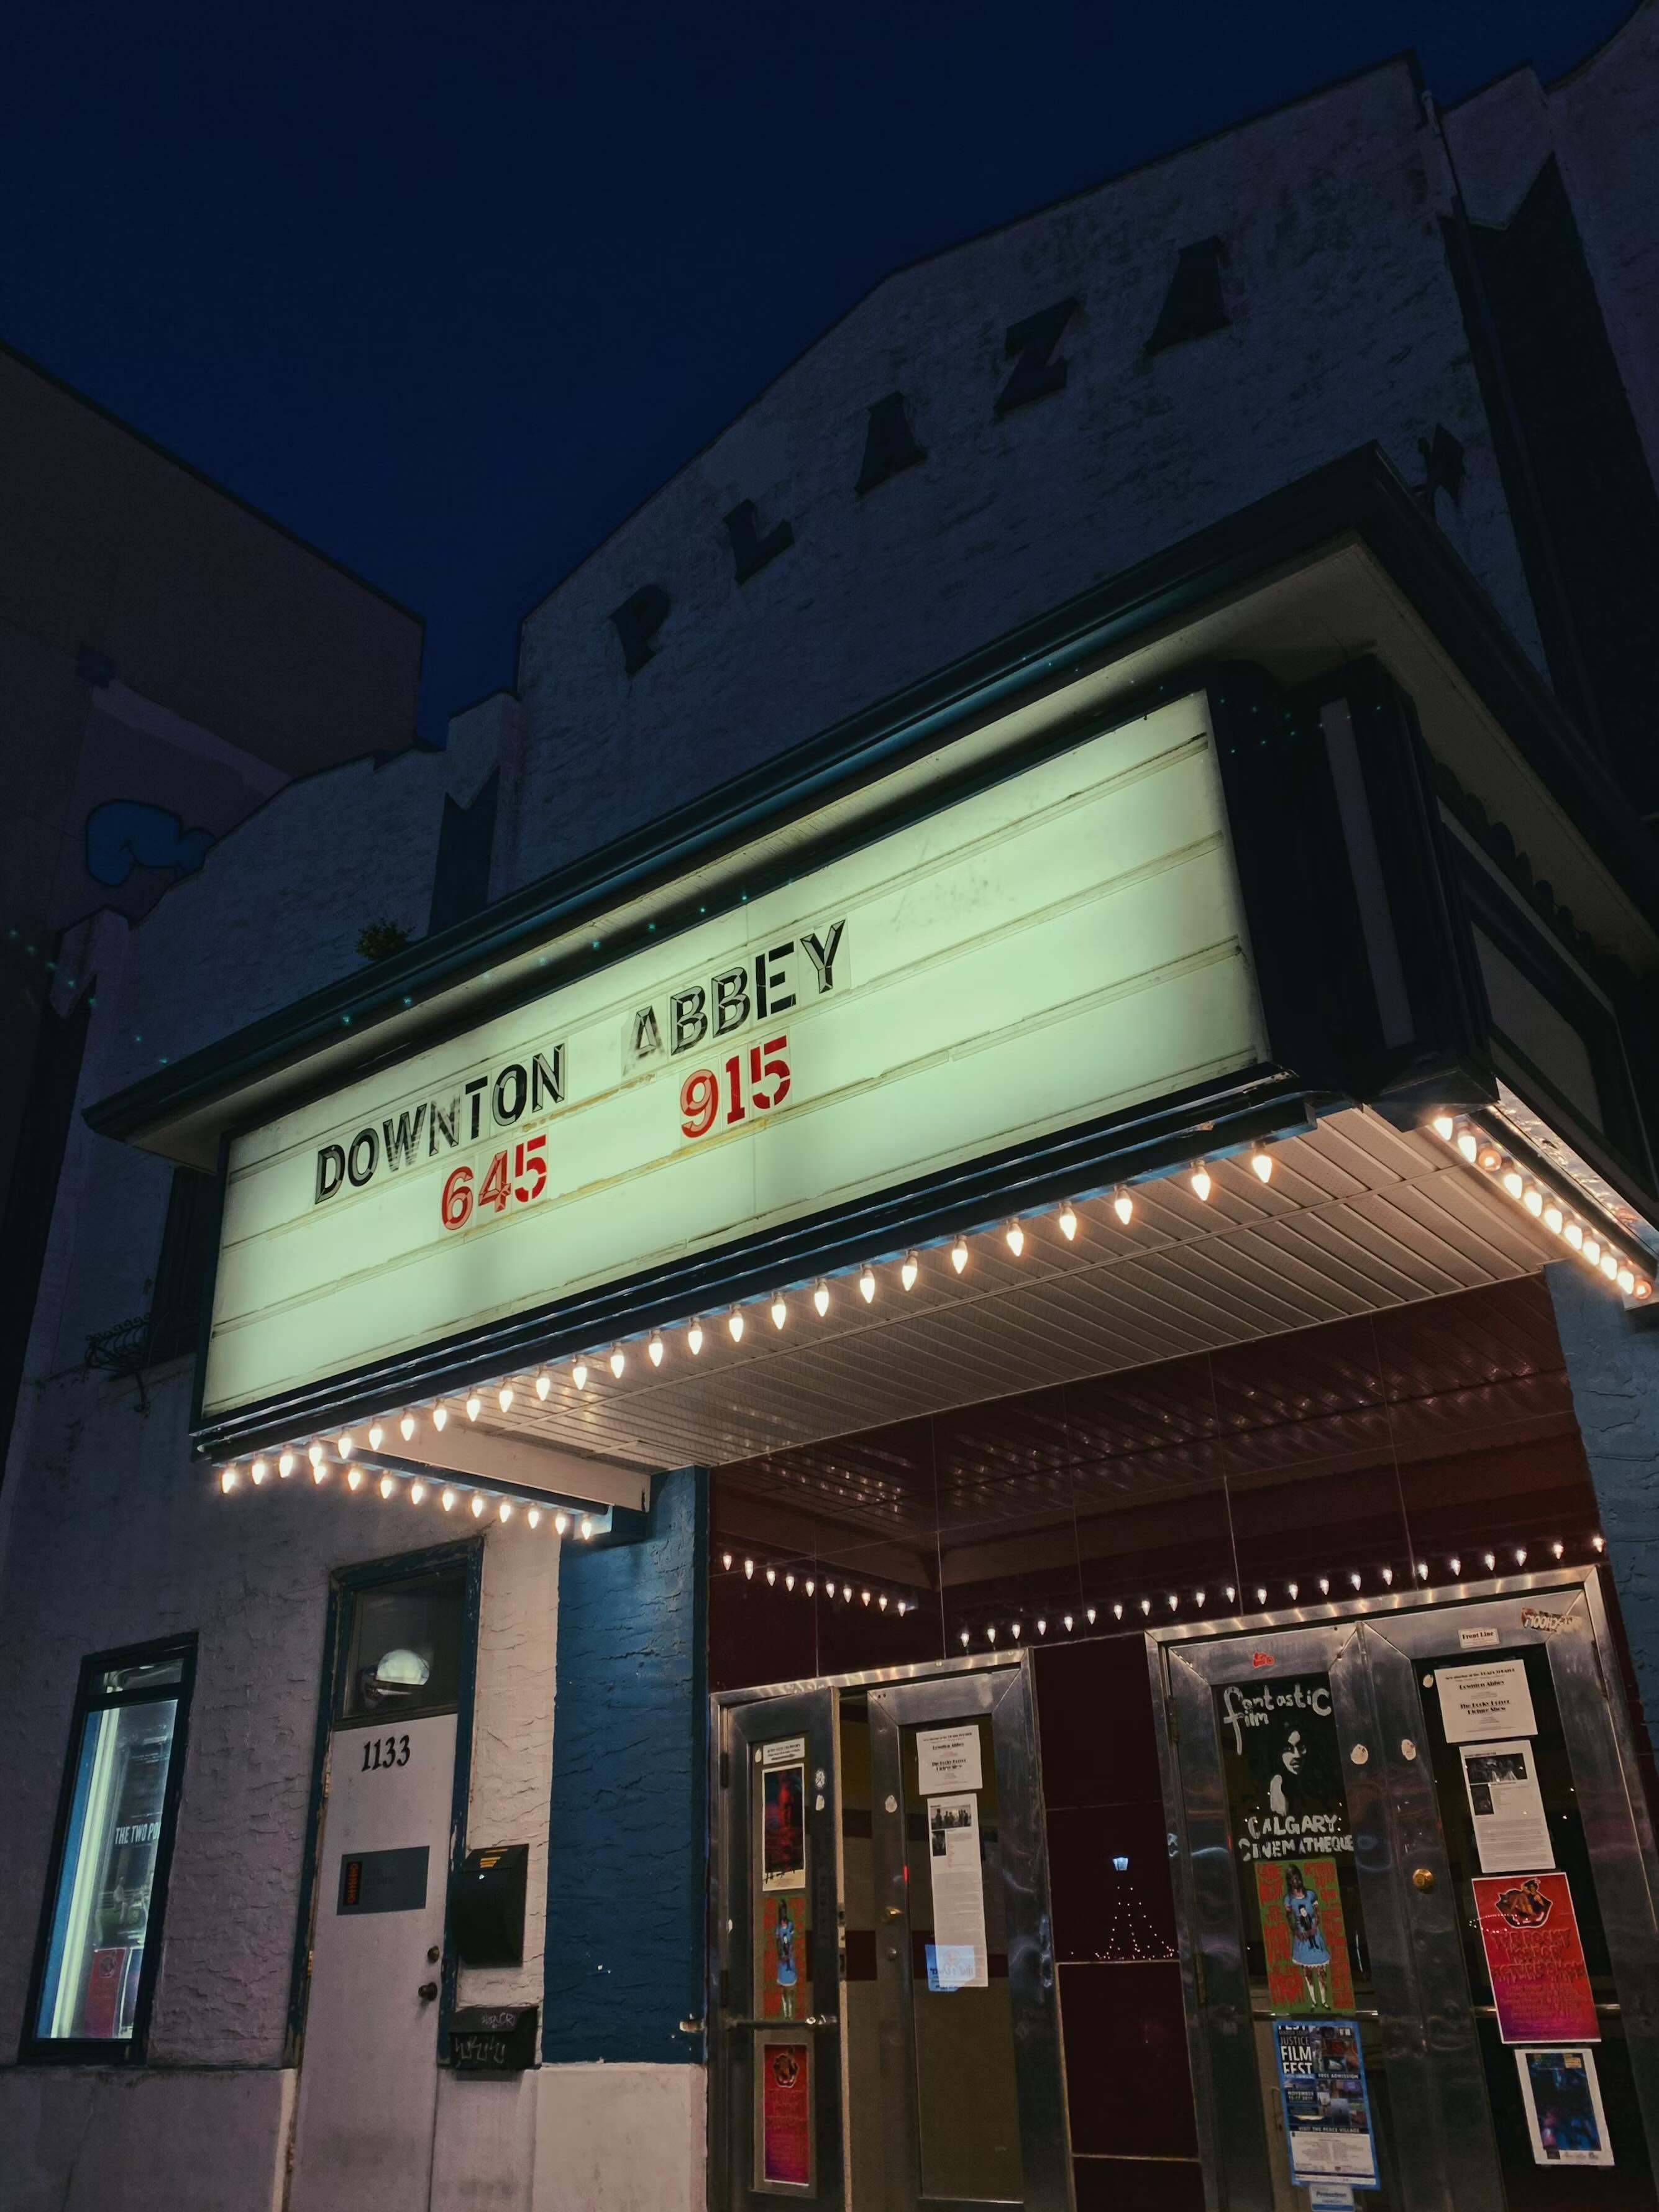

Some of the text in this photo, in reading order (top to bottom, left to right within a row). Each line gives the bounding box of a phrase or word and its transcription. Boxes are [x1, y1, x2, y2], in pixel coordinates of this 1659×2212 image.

[607, 235, 1232, 681] PLAZA
[315, 920, 846, 1205] DOWNTON ABBEY
[442, 1035, 790, 1230] 645 915
[362, 1734, 410, 1772] 1133
[115, 1821, 161, 1845] THE TWO PO
[1248, 1814, 1338, 1839] CALGARY
[1238, 1834, 1355, 1862] CINEMATHEQUE
[1281, 2036, 1310, 2045] JUSTICE
[1281, 2046, 1312, 2061] FILM
